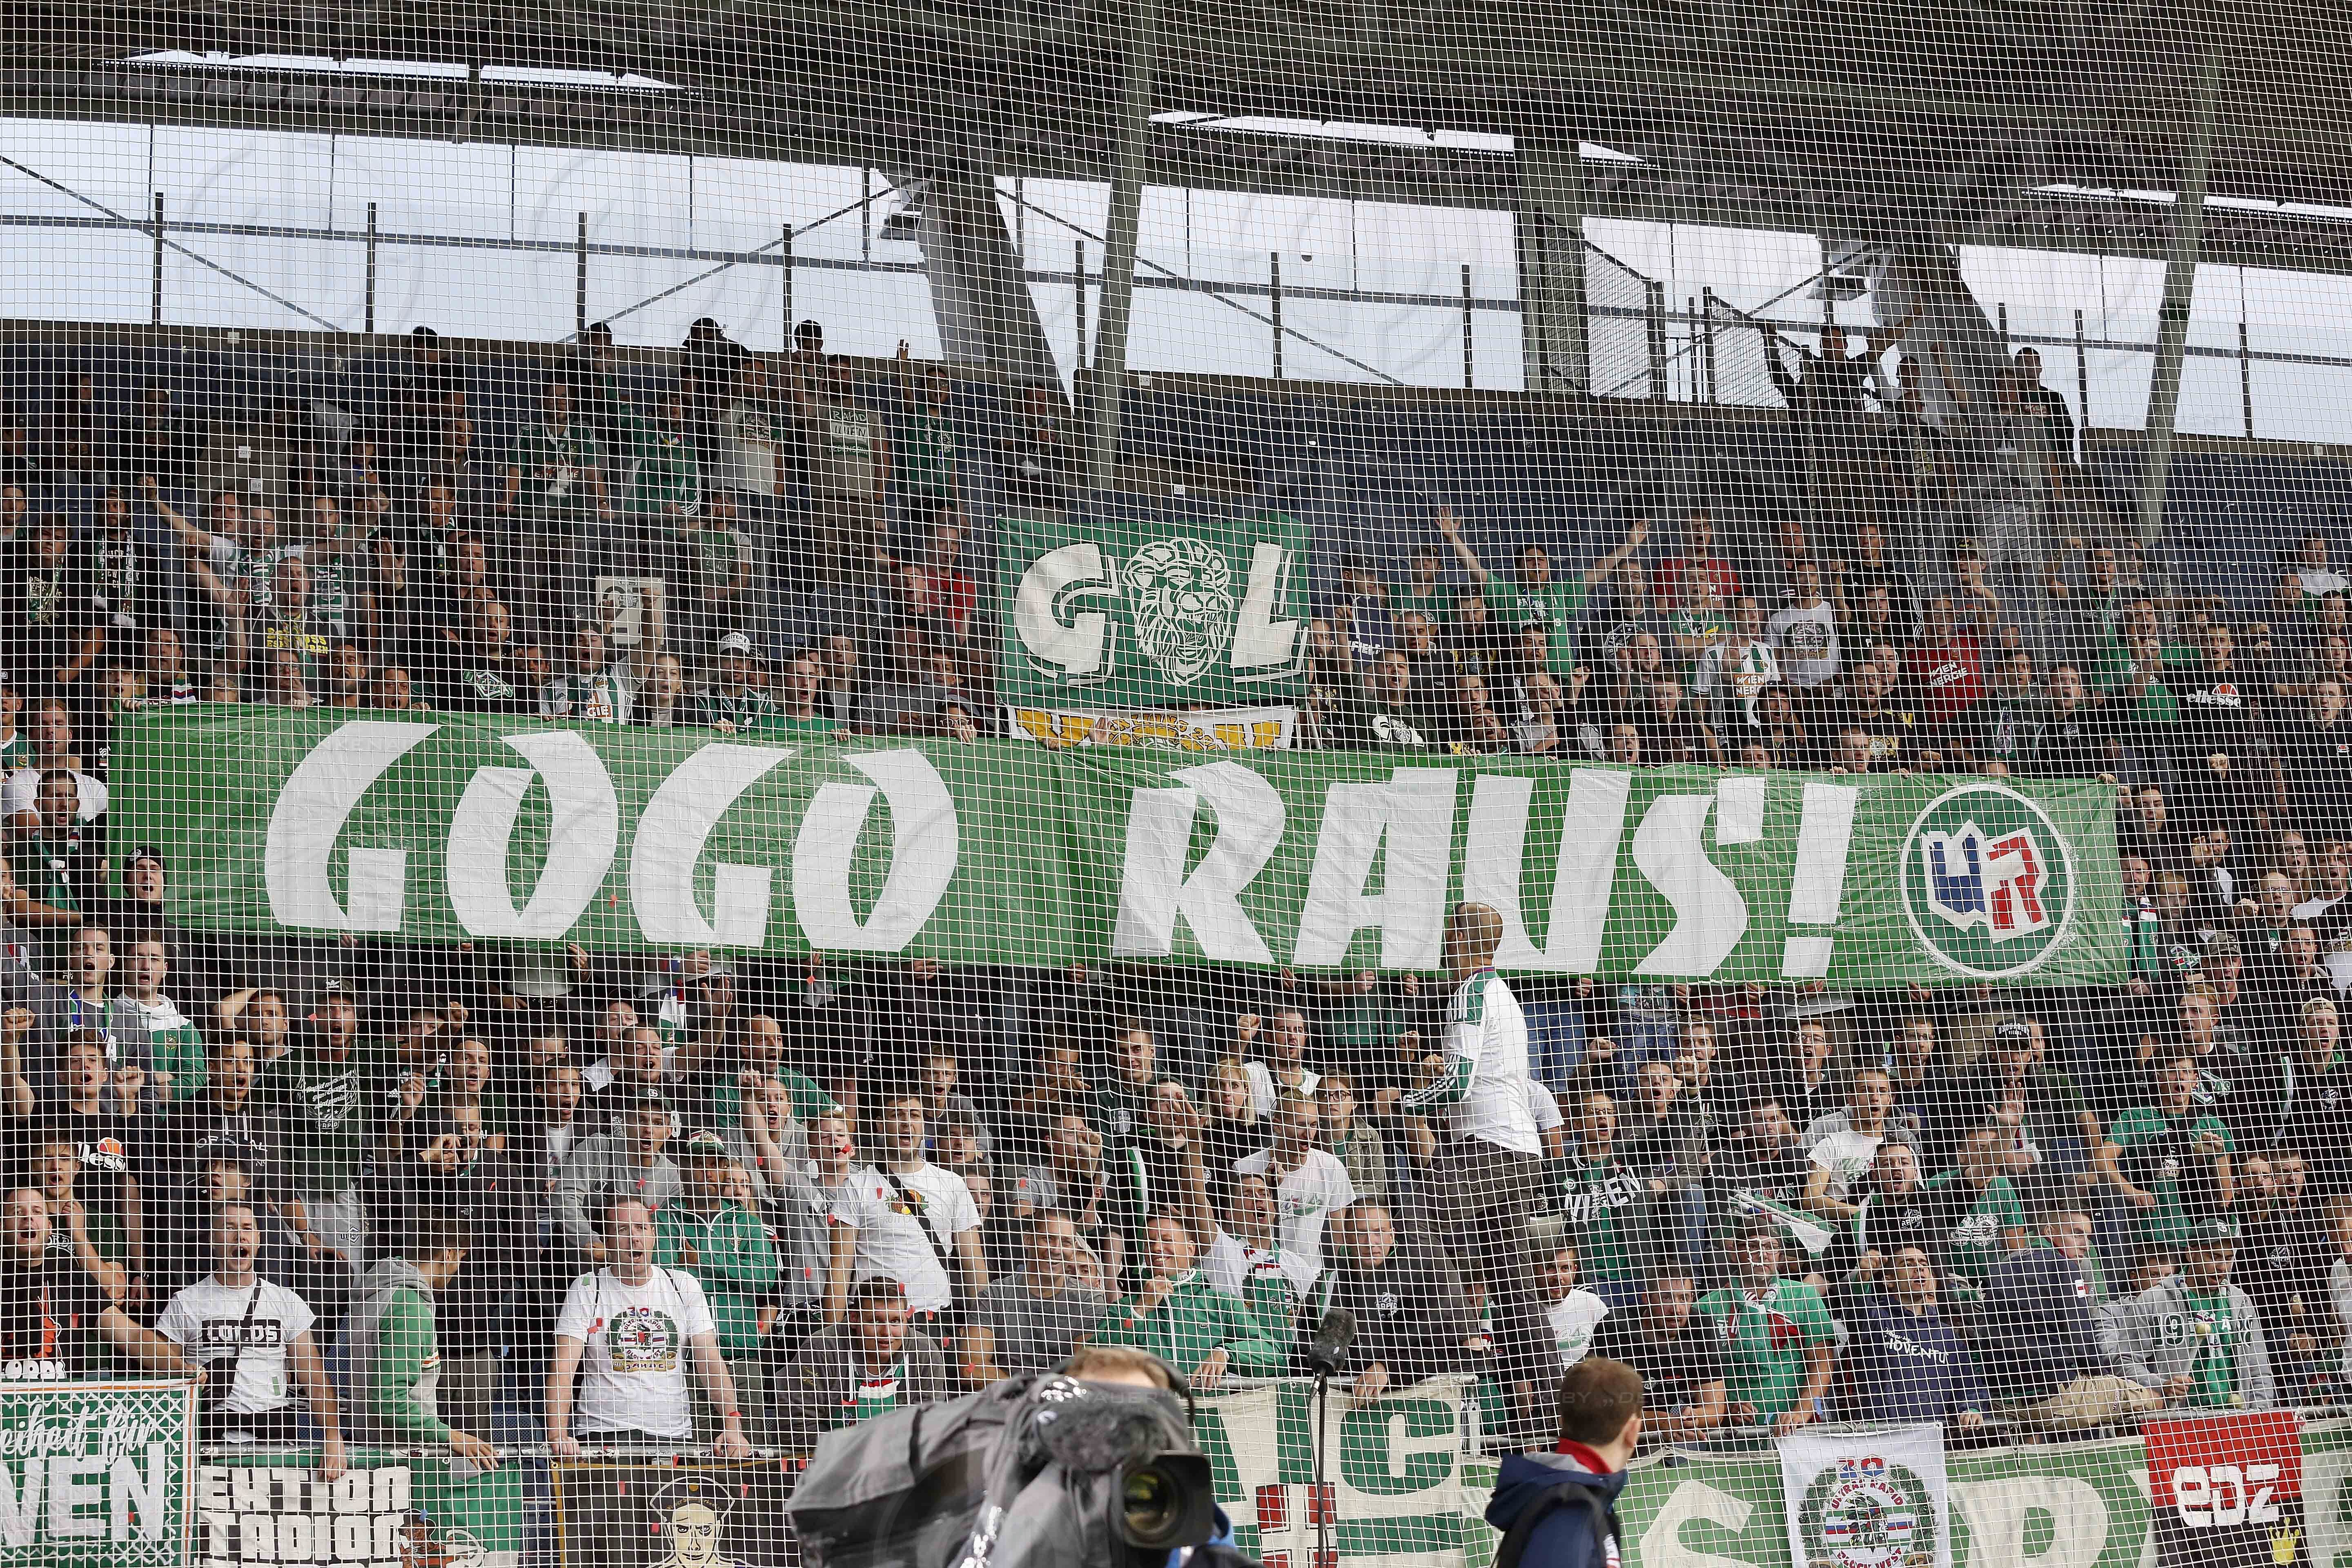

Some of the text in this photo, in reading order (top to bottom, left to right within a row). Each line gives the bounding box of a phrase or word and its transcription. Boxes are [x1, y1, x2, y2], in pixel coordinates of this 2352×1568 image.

[833, 411, 866, 421] RAPID
[1737, 675, 1764, 684] WIEN
[2187, 690, 2241, 707] ellesse
[264, 720, 1860, 978] GOGO RAUS!
[1831, 1479, 1904, 1510] ULTRAS RAPID
